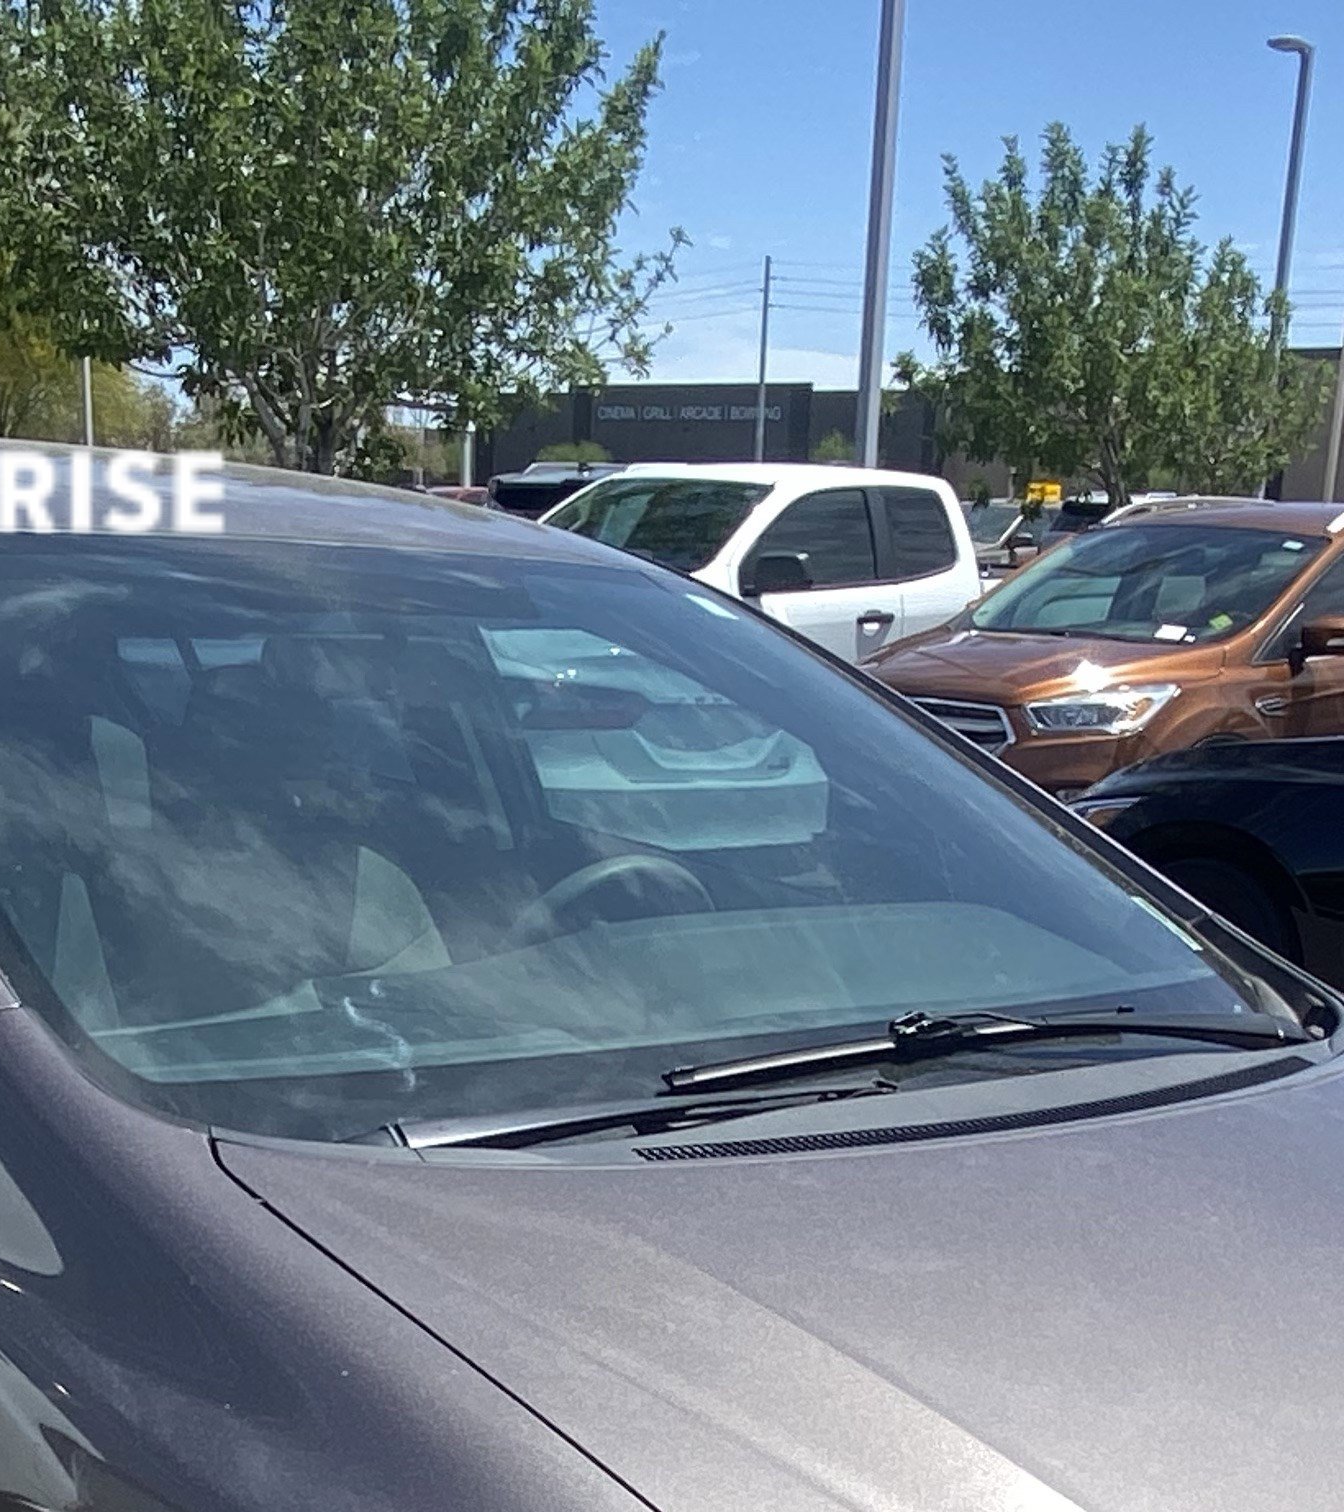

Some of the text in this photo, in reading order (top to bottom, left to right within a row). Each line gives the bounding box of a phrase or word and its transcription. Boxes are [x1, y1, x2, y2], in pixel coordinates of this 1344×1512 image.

[597, 404, 782, 421] CINEMA GRILL ARCADE BOWNG
